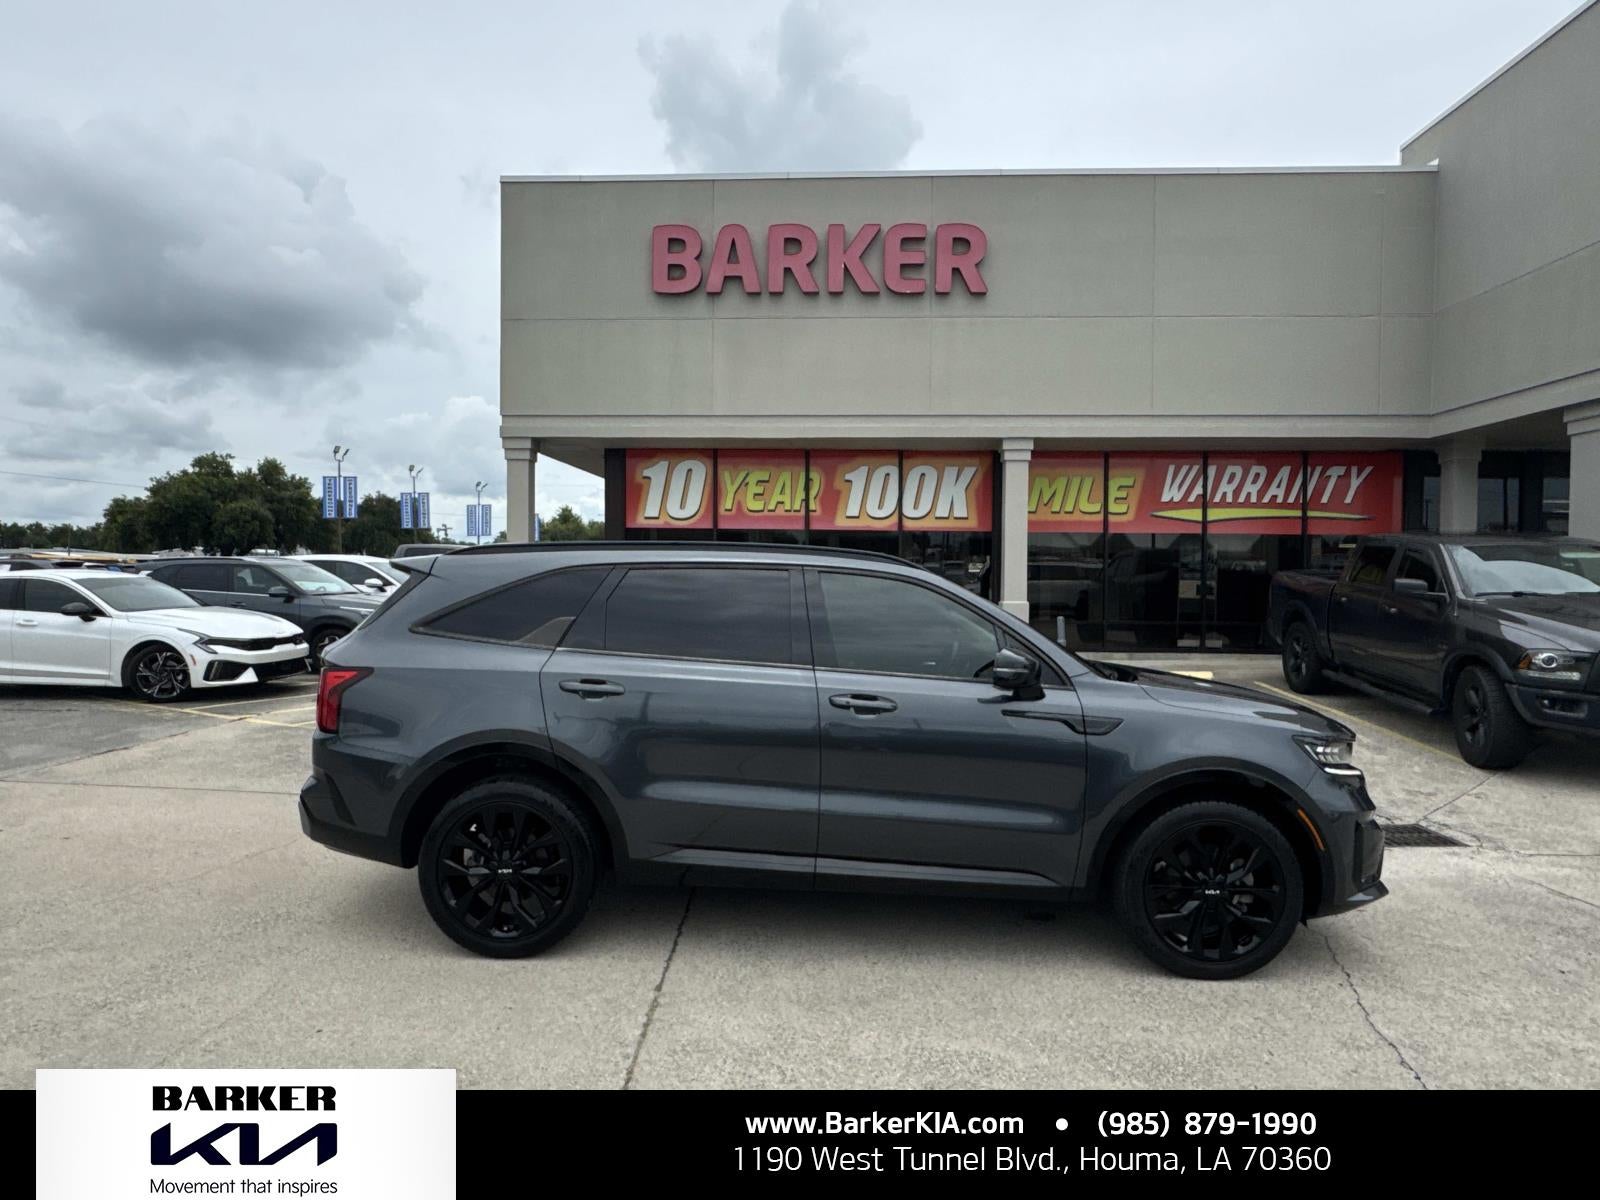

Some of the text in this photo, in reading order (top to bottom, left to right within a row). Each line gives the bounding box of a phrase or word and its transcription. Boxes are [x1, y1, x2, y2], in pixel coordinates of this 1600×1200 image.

[651, 222, 989, 297] BARKER
[641, 459, 1375, 521] 10 YEAR 100K MILE WARRANTY
